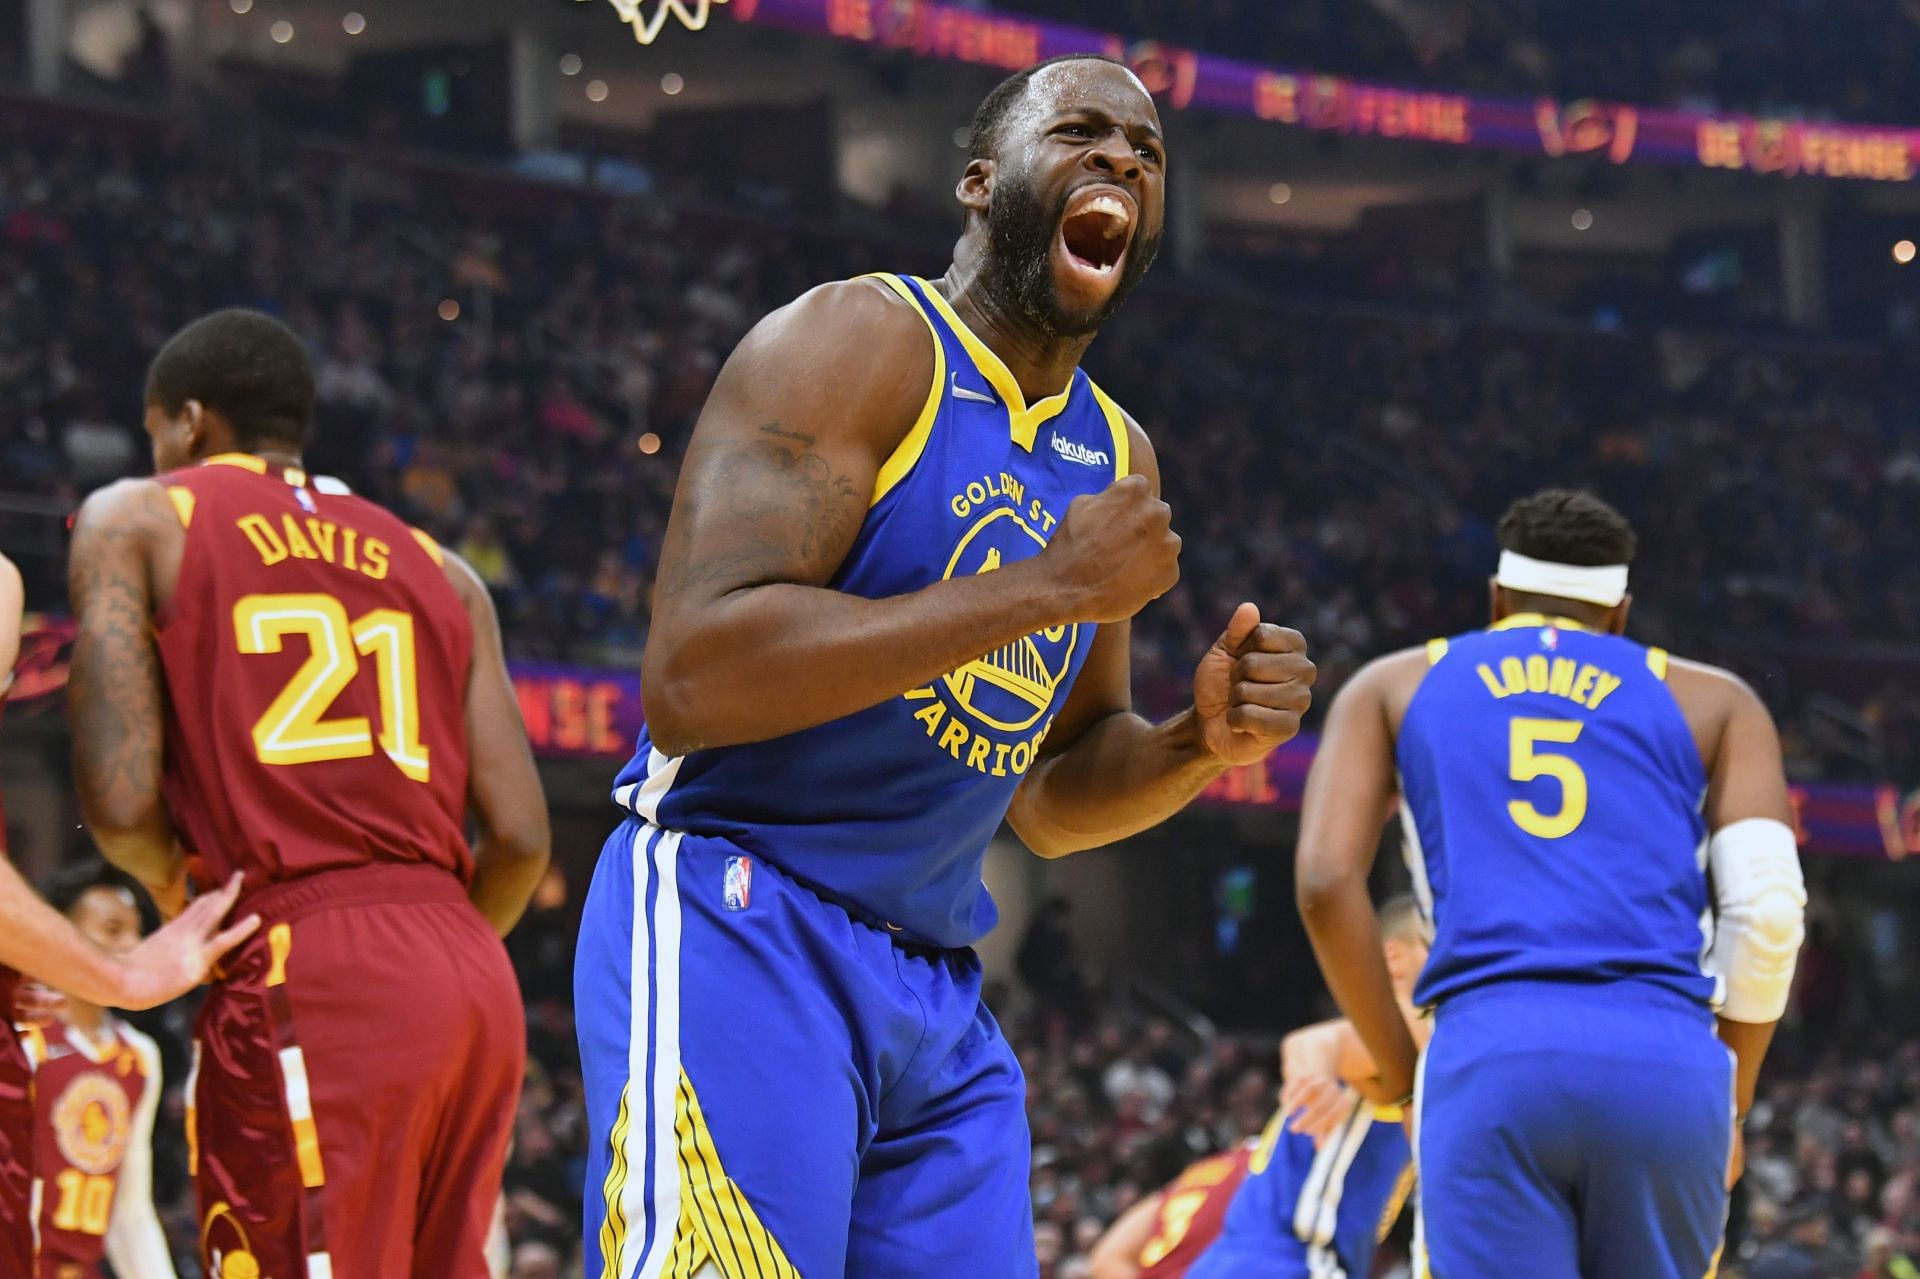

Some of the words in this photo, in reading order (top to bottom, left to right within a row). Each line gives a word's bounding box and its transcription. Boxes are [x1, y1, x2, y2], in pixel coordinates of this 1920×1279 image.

[951, 472, 1025, 518] GOLDEN
[1029, 499, 1057, 533] ST
[236, 512, 391, 580] DAVIS
[232, 593, 430, 784] 21
[1475, 654, 1622, 711] LOONEY
[1507, 716, 1588, 839] 5
[53, 1168, 115, 1236] 10
